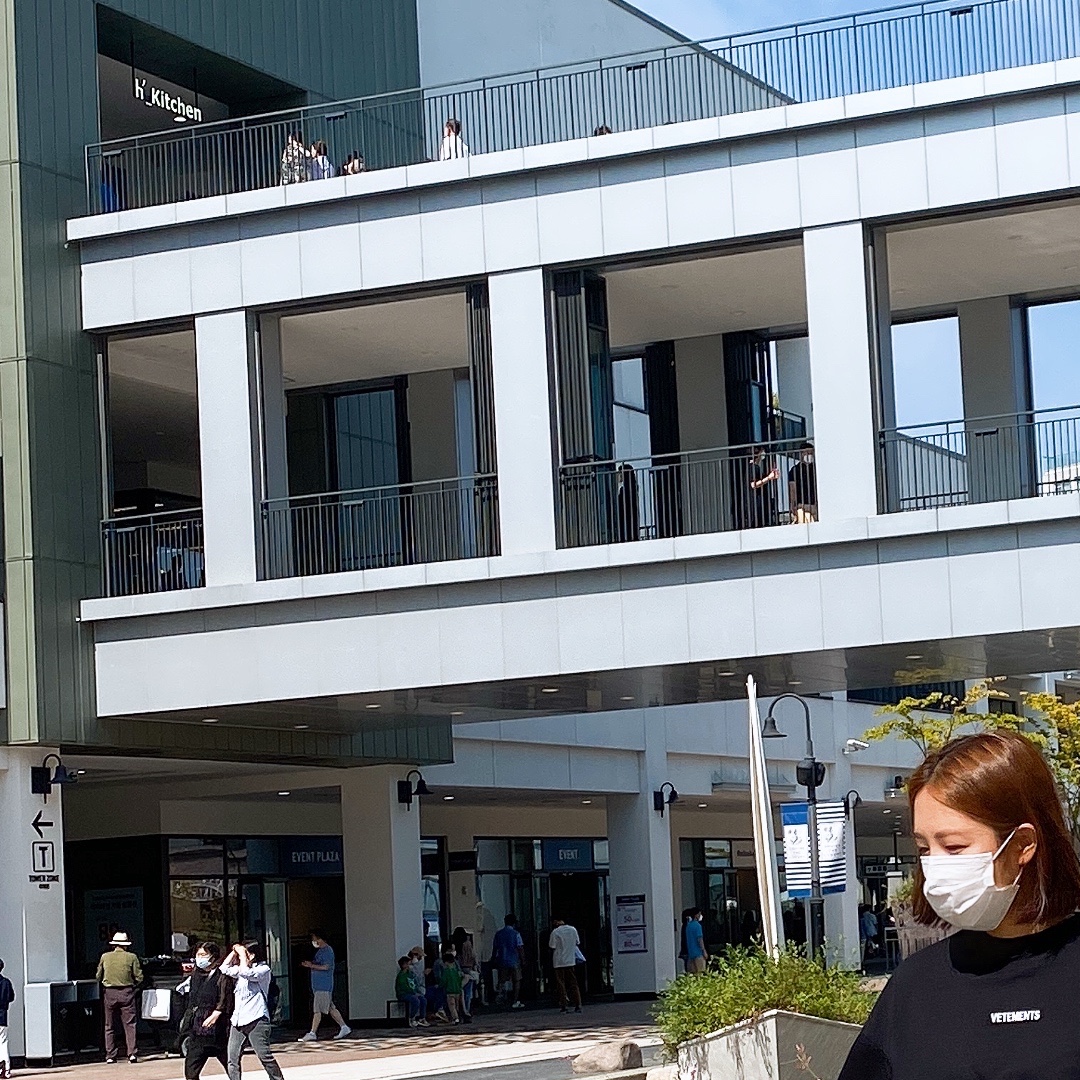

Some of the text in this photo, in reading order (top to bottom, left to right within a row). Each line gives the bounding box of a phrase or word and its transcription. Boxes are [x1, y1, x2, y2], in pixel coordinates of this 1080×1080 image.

[38, 845, 48, 868] T
[291, 851, 340, 862] EVENT PLAZA
[558, 849, 578, 860] EVENT
[990, 1009, 1041, 1023] VETEMENTS
